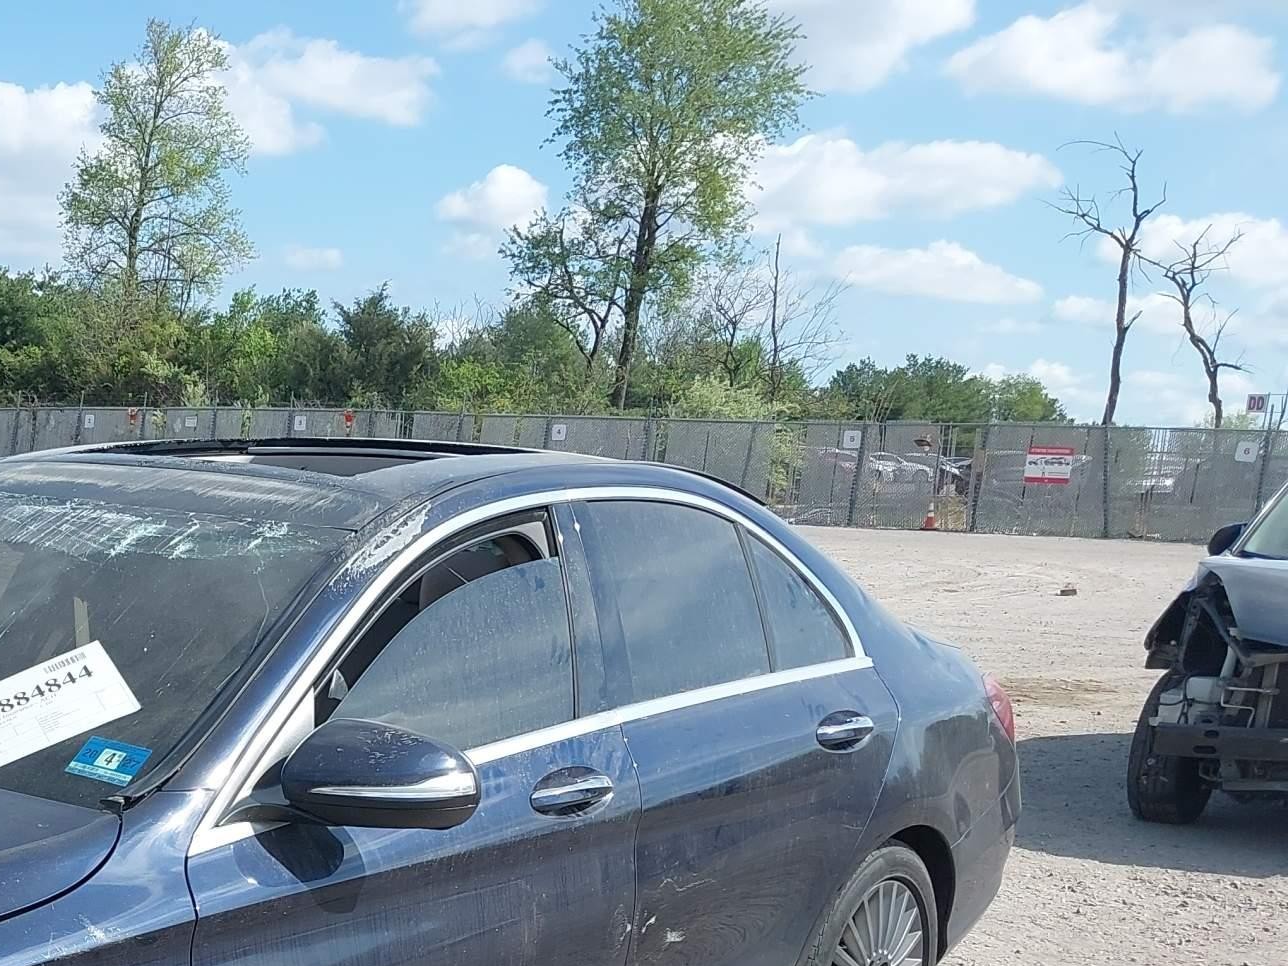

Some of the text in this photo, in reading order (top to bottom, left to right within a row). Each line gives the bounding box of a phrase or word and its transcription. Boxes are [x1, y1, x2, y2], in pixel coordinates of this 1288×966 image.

[1247, 396, 1265, 411] DD
[1243, 447, 1250, 455] 6
[104, 752, 117, 766] 4
